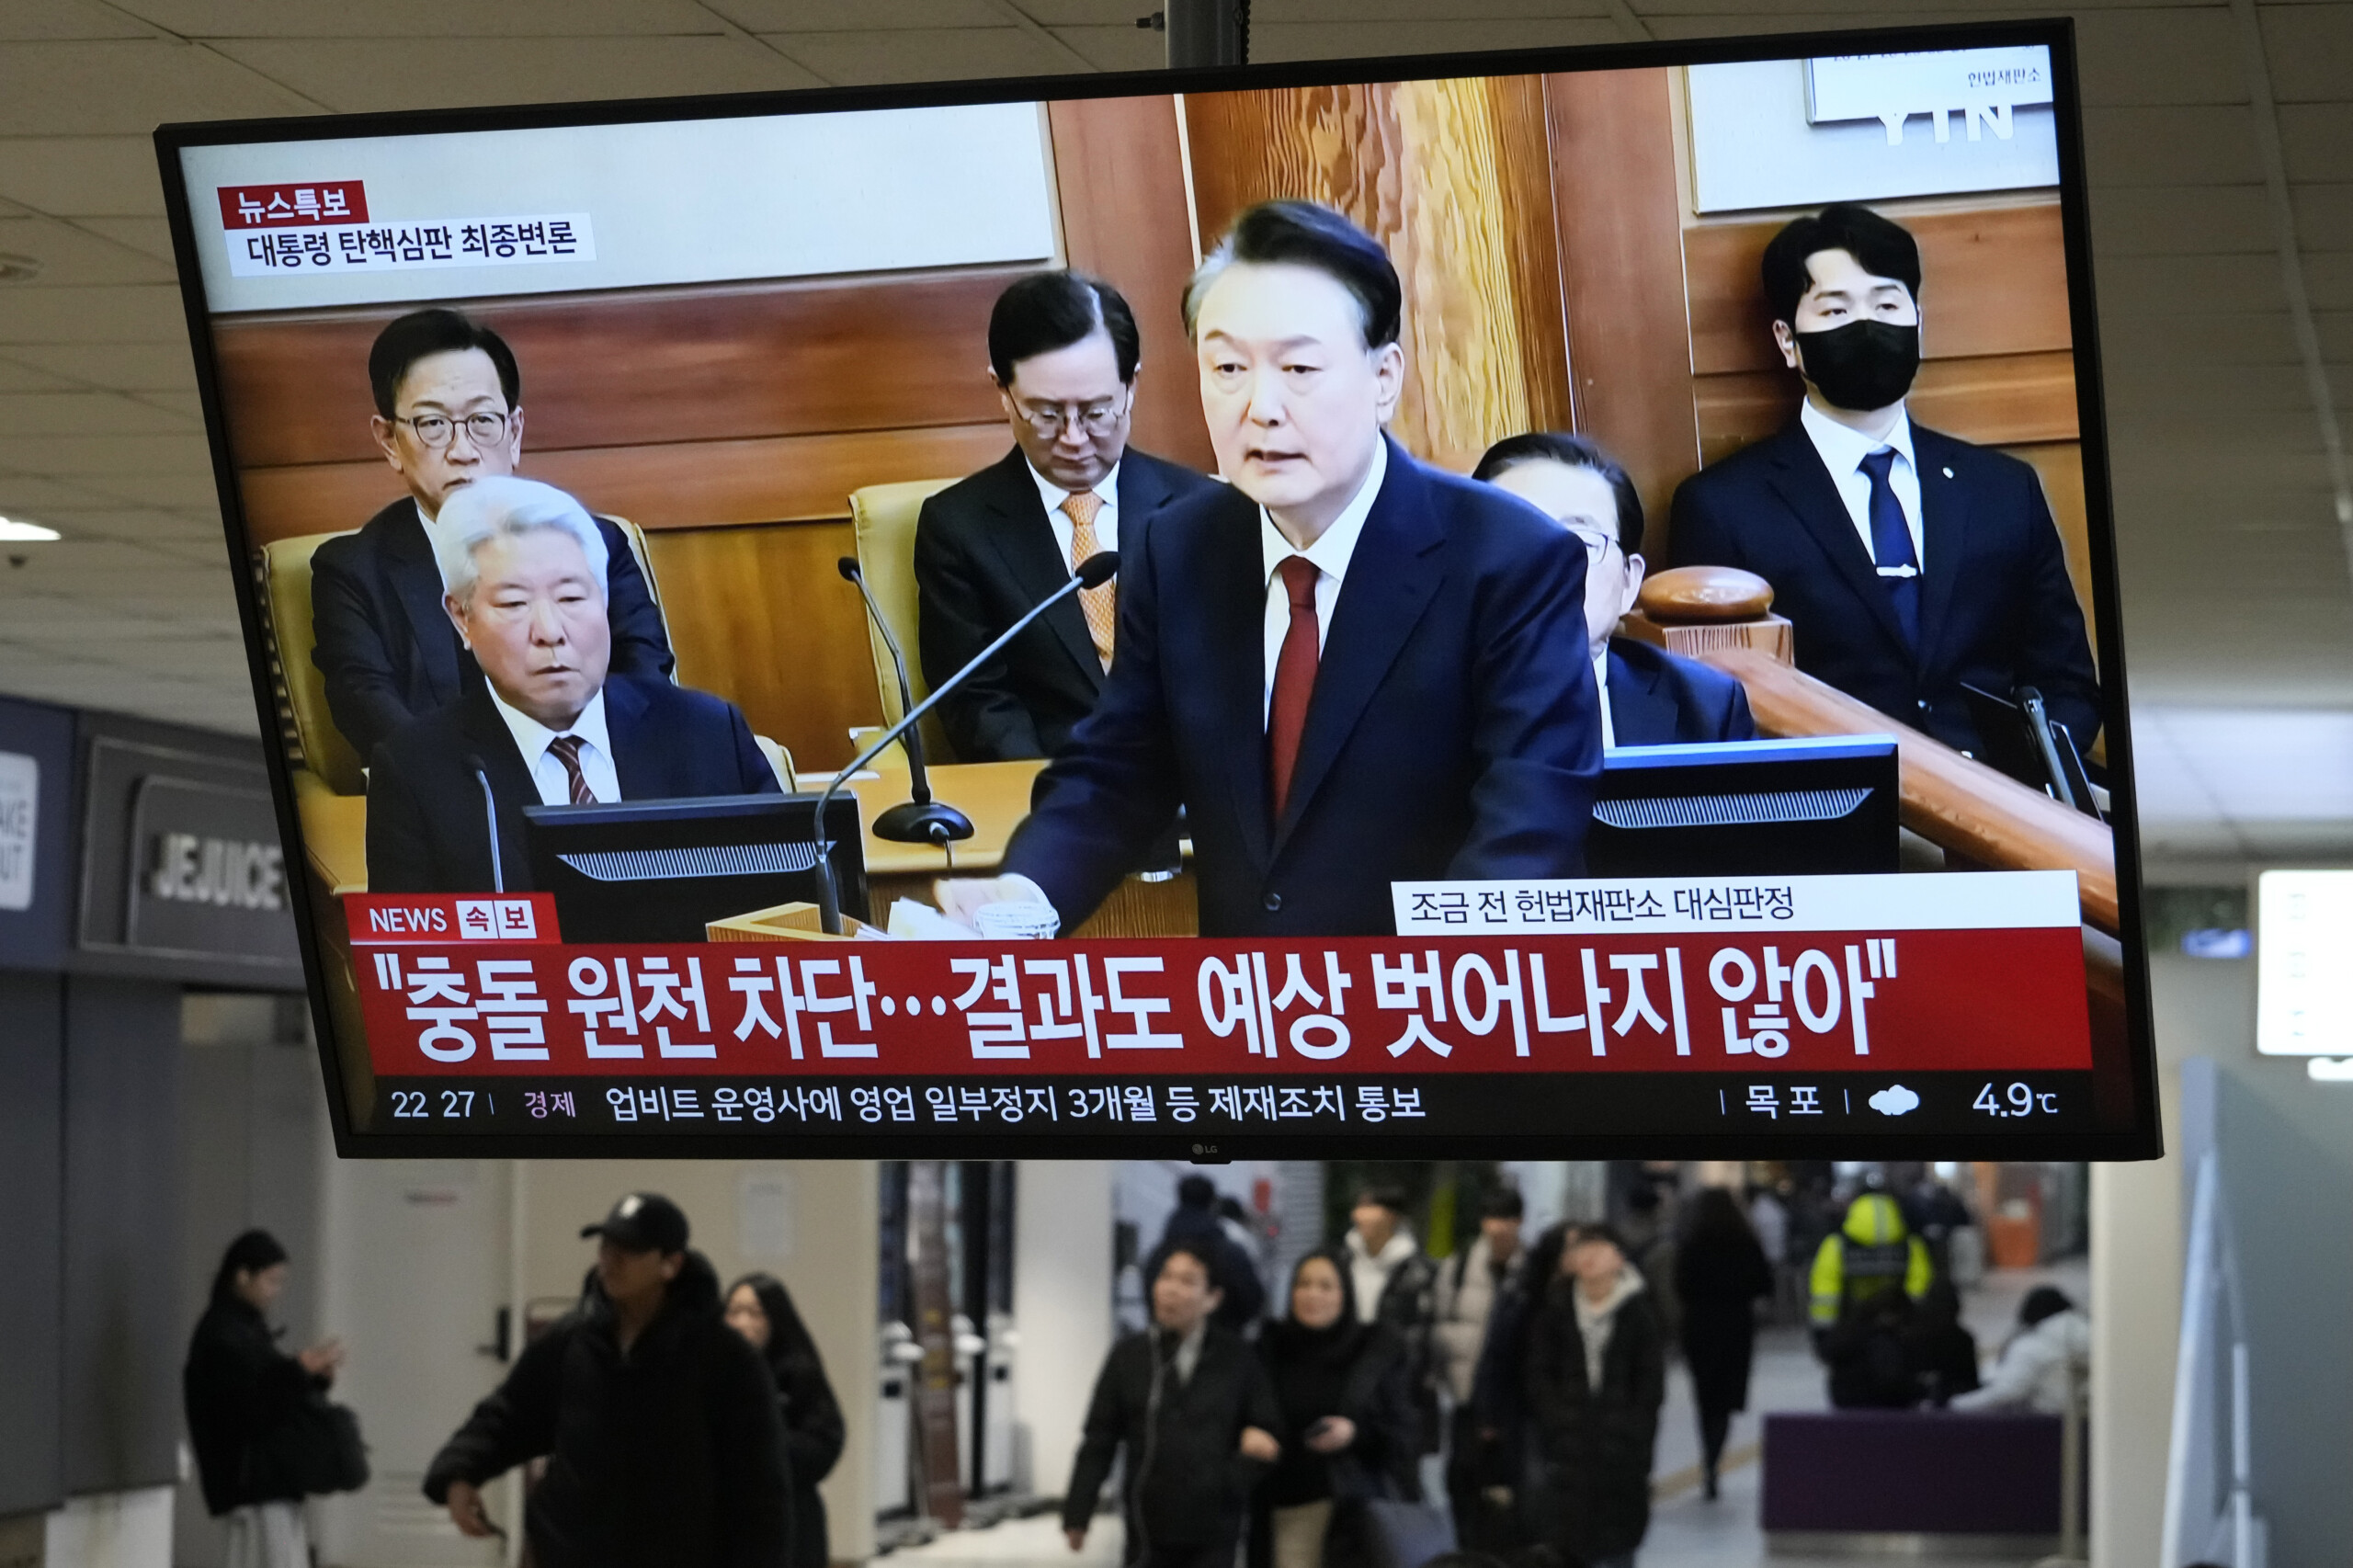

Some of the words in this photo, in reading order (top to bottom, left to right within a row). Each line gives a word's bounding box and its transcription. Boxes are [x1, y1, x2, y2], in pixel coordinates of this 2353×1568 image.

[237, 187, 351, 224] 뉴스특보
[246, 233, 332, 267] 대통령
[338, 225, 453, 264] 탄핵심판
[460, 221, 577, 258] 최종변론
[152, 832, 283, 909] JEJUICE
[369, 907, 448, 932] NEWS
[465, 904, 529, 932] 속보
[1411, 892, 1470, 924] 조금
[1478, 890, 1508, 923] 전
[1515, 888, 1666, 923] 헌법재판소
[1673, 886, 1794, 921] 대심판정
[372, 953, 551, 1062] "충돌
[566, 956, 717, 1059] 원천
[1197, 950, 1352, 1060] 예상
[1370, 947, 1691, 1059] 벗어나지
[1708, 937, 1897, 1058] 않아"
[524, 1091, 576, 1119] 경제
[606, 1086, 705, 1121] 업비트
[711, 1085, 842, 1123] 운영사에
[850, 1085, 915, 1123] 영업
[925, 1085, 1058, 1123] 일부정지
[1068, 1085, 1157, 1122] 3개월
[1165, 1086, 1200, 1122] 등
[1208, 1085, 1346, 1122] 제재조치
[1355, 1085, 1427, 1122] 통보
[1204, 1145, 1218, 1153] LG
